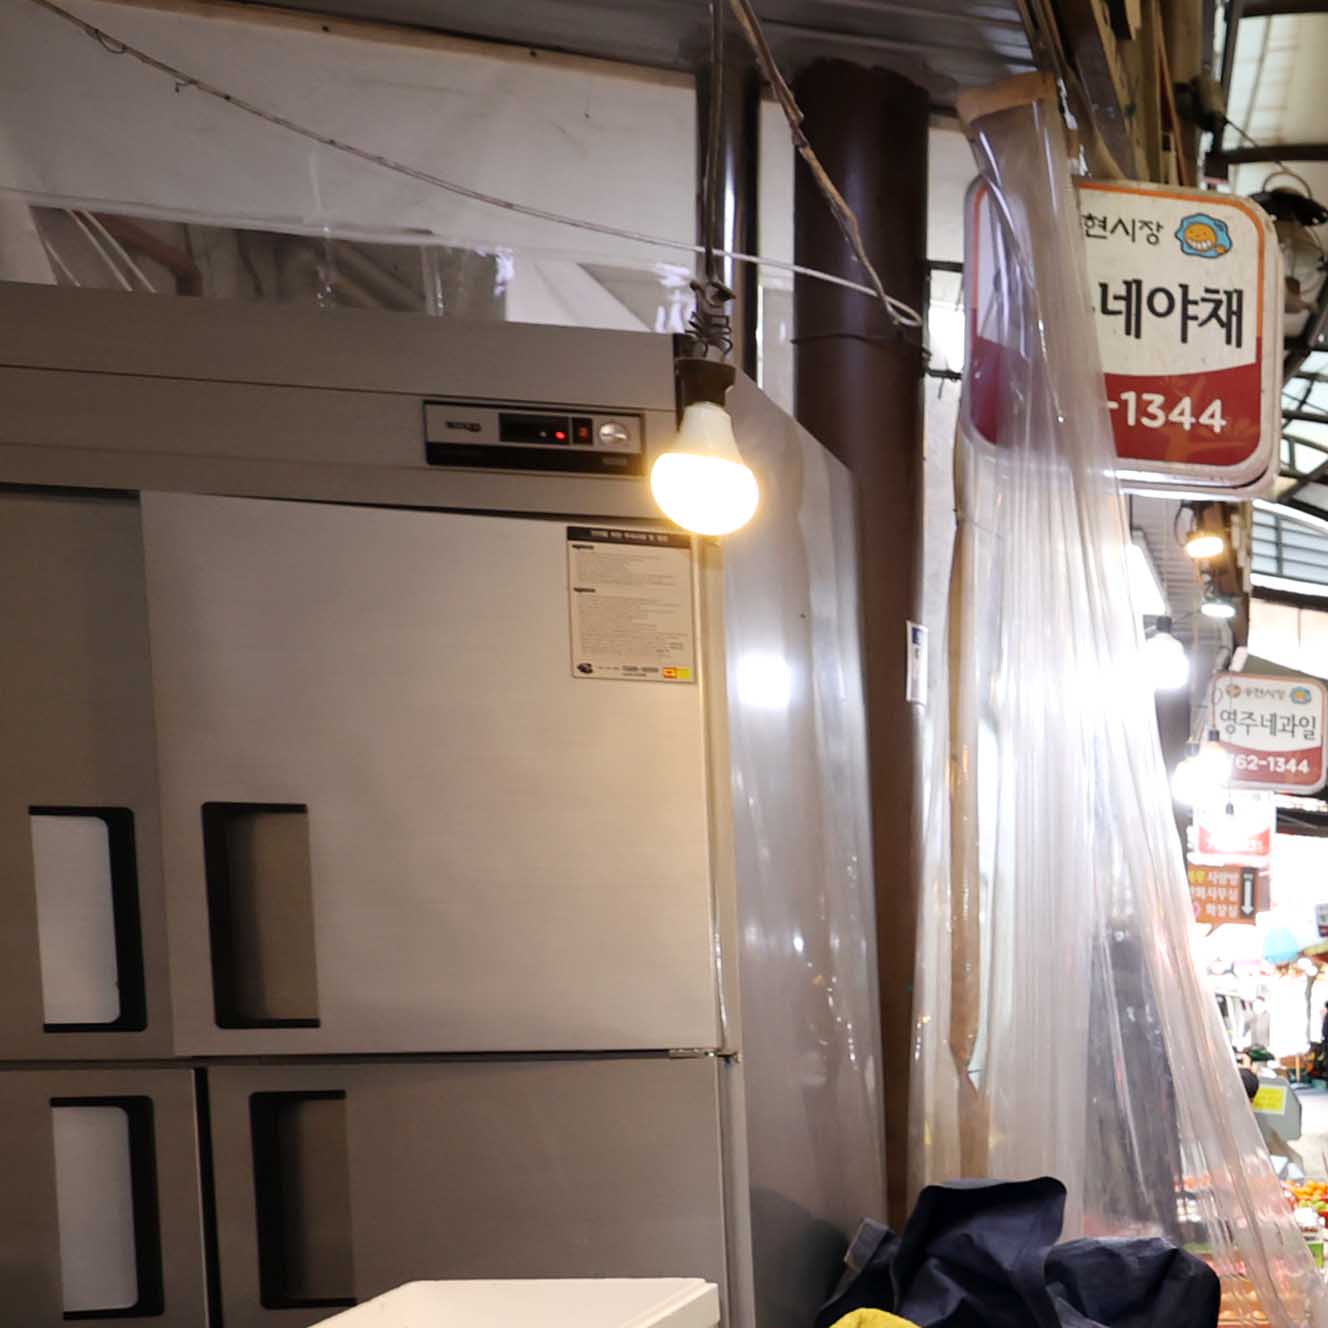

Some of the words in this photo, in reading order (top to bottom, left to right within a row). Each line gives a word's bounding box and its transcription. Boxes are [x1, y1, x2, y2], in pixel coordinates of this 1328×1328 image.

[1082, 212, 1164, 246] 현시장
[1097, 277, 1244, 349] 네야채
[1219, 710, 1318, 741] 영주네과일
